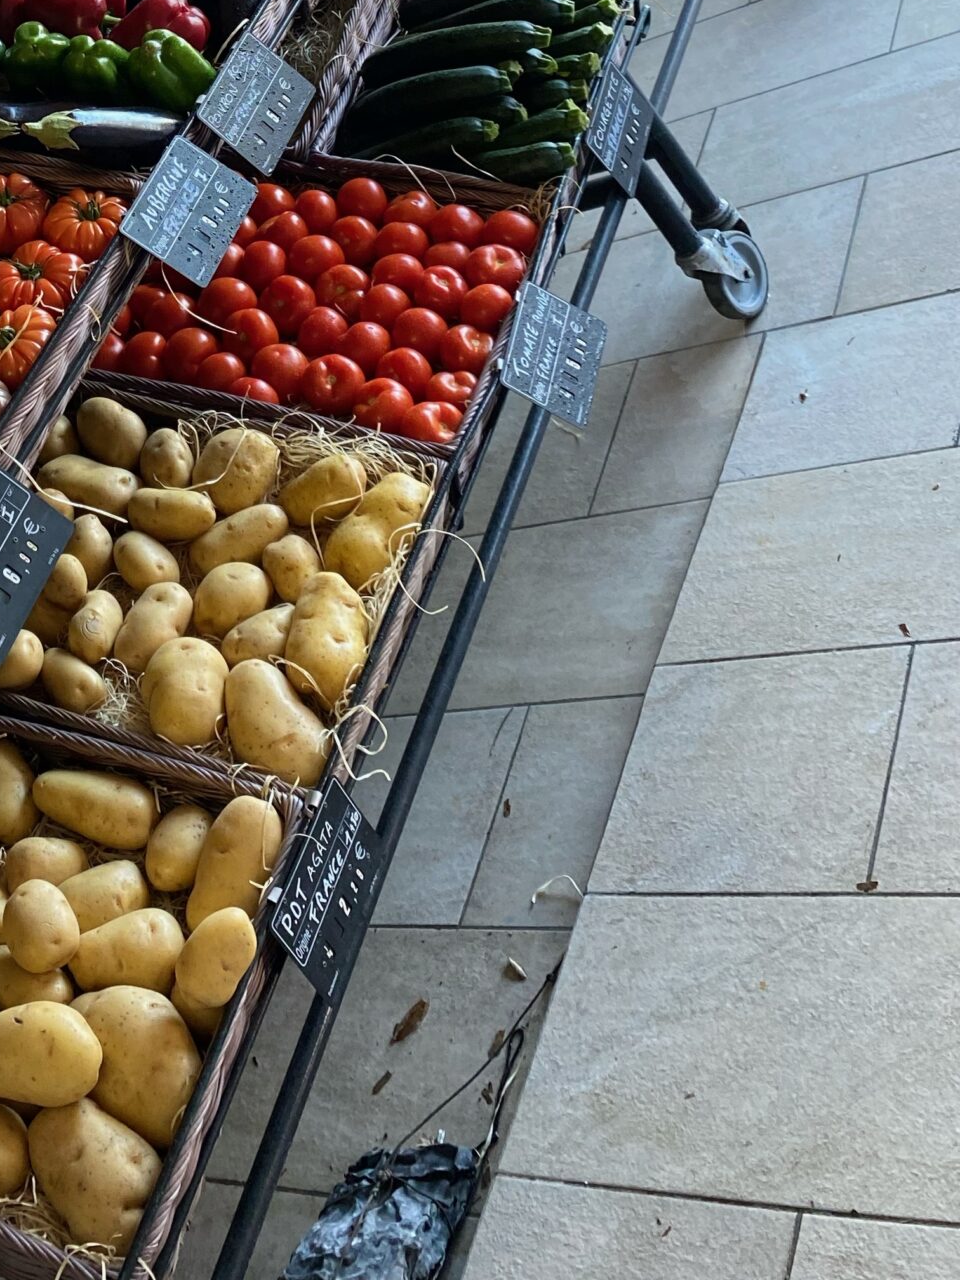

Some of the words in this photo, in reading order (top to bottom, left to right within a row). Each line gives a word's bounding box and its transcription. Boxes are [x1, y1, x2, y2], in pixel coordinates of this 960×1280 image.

[208, 83, 239, 129] POIVRON
[249, 50, 266, 72] VERT
[235, 78, 261, 122] FRANCE
[279, 77, 292, 91] €
[593, 71, 620, 150] COURGETTE
[606, 103, 625, 152] FRANCE
[163, 178, 200, 237] FRANCE
[213, 180, 229, 194] €
[512, 322, 540, 378] TOMATE
[531, 288, 551, 325] RONDE
[569, 320, 584, 334] €
[536, 335, 558, 381] FRANCE
[1, 539, 40, 586] 6,99
[23, 516, 41, 537] €
[305, 820, 335, 883] AGATA
[354, 839, 367, 861] €
[307, 848, 346, 924] FRANCE
